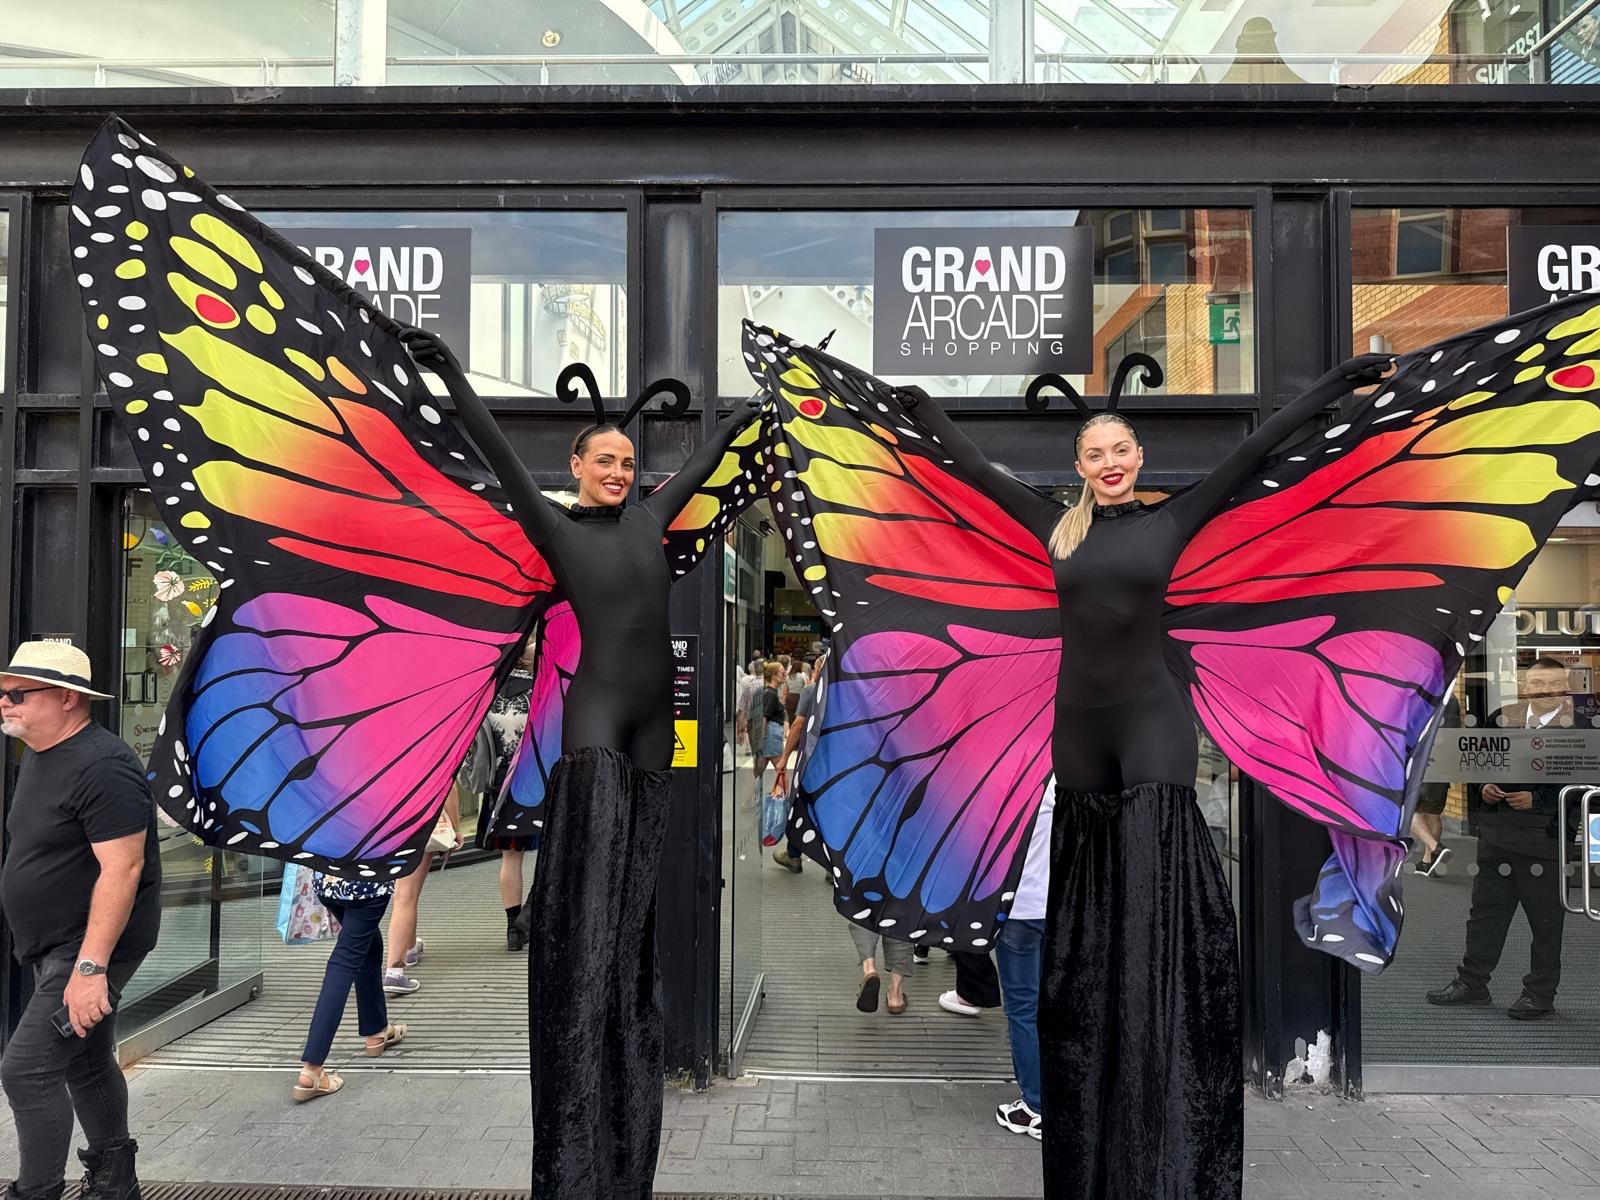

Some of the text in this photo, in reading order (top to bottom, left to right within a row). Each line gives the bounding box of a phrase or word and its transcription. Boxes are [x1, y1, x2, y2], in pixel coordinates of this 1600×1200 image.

[297, 246, 443, 292] RAND
[902, 246, 1066, 292] GRAND
[902, 295, 1063, 340] ARCADE
[900, 341, 1063, 356] SHOPPING
[783, 623, 811, 631] Poundland
[1458, 736, 1511, 752] GRAND
[1459, 752, 1511, 767] ARCADE
